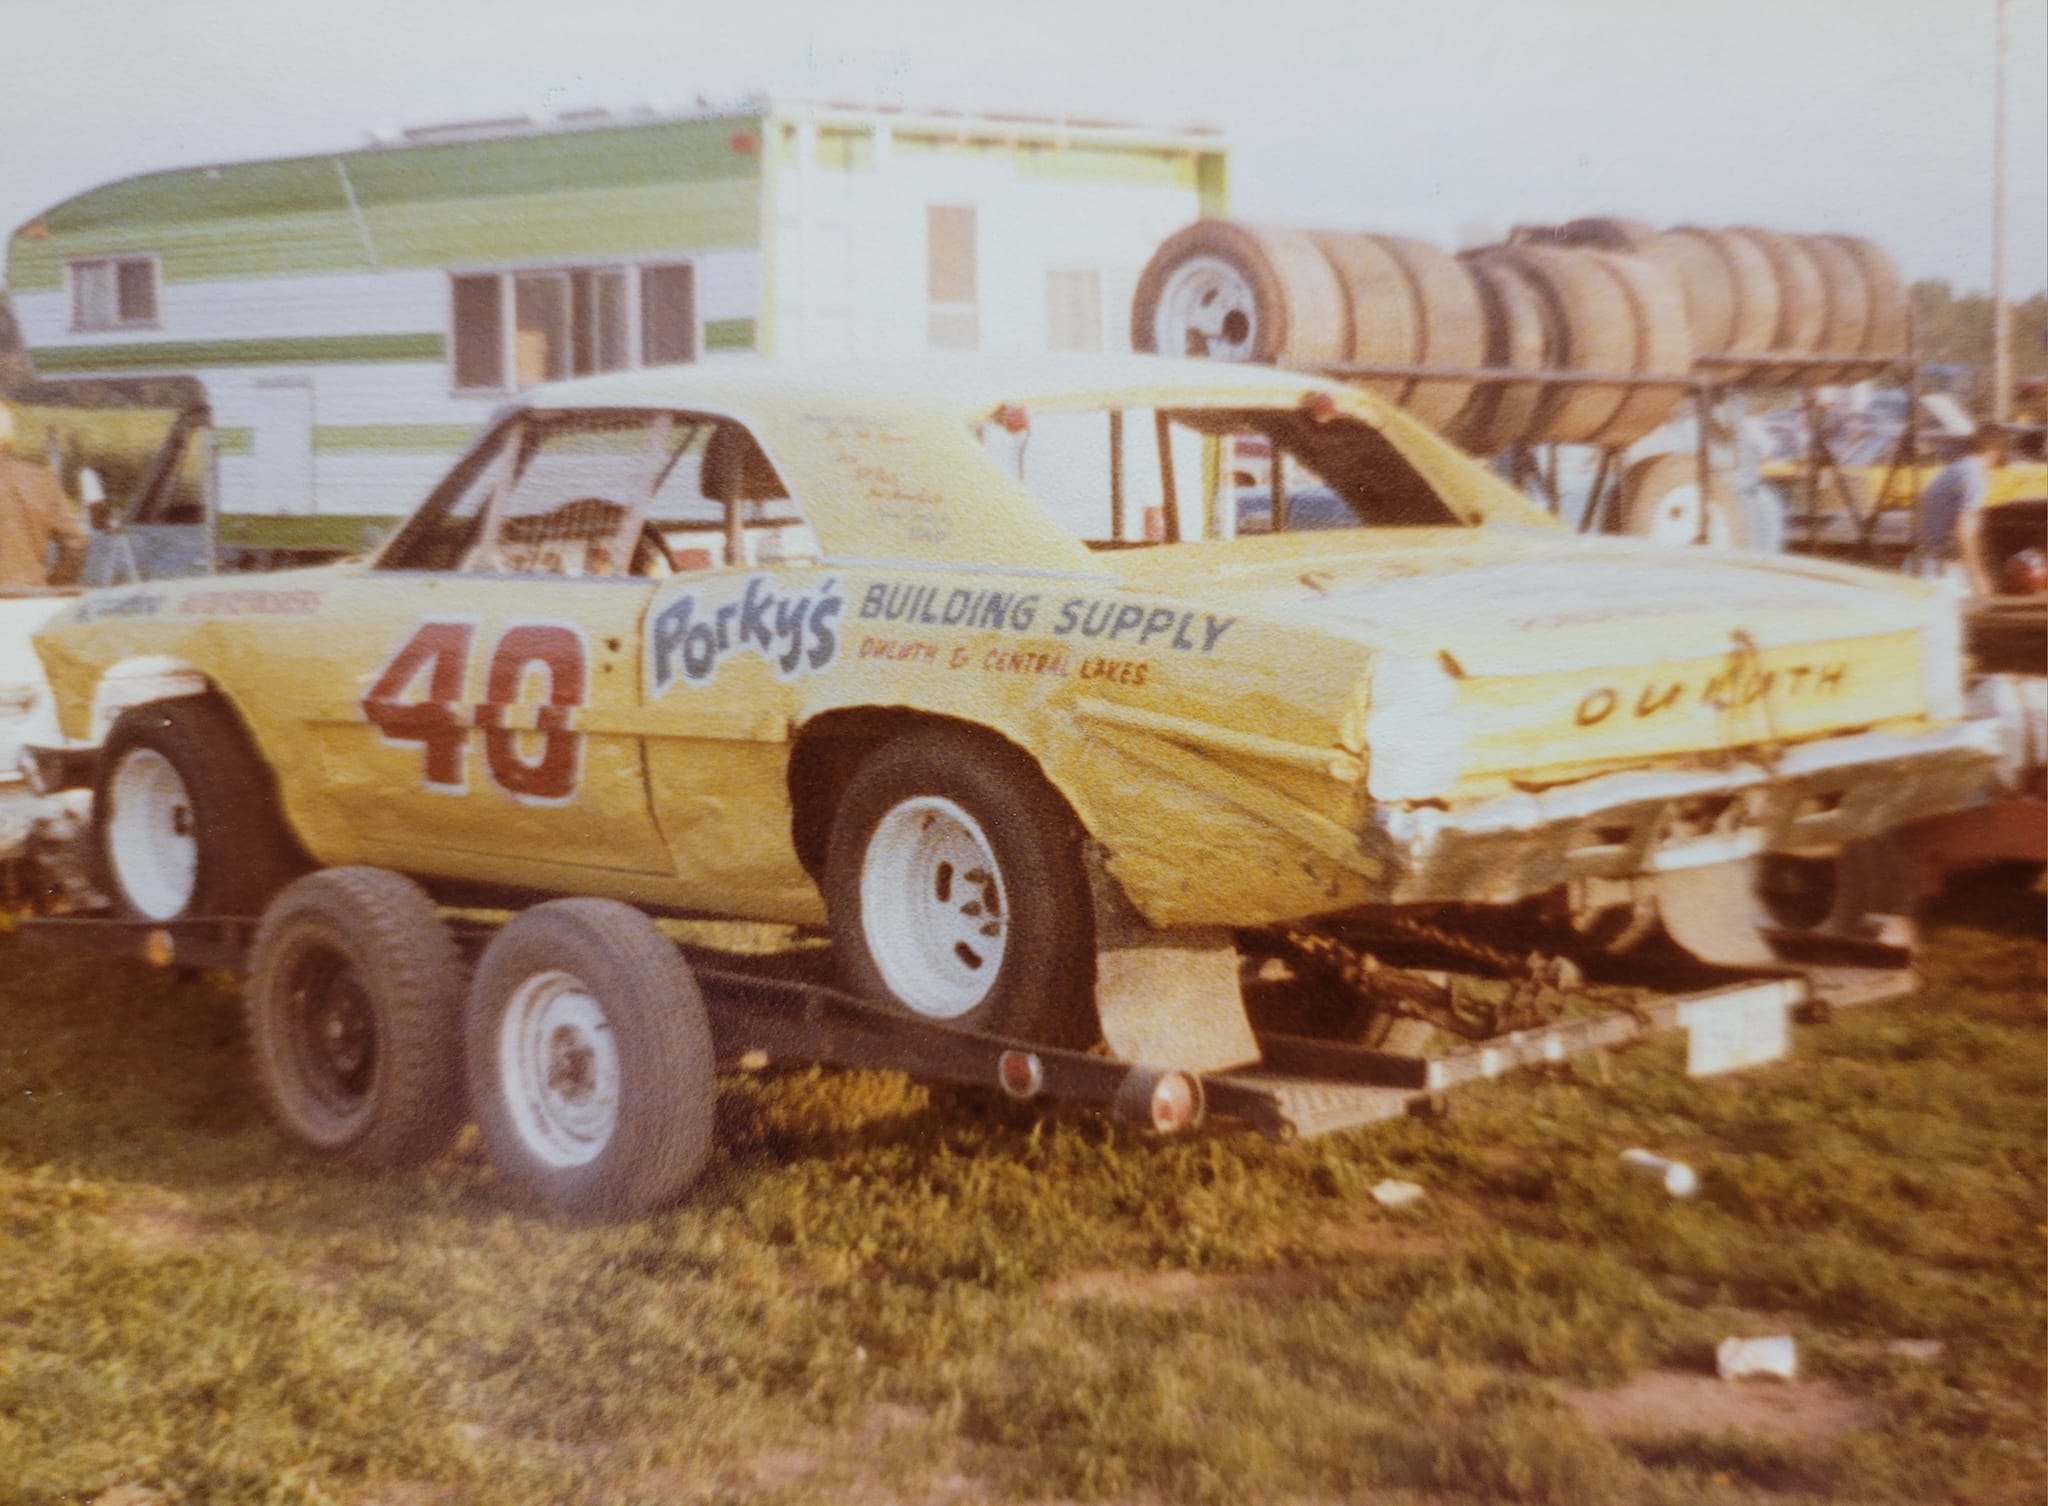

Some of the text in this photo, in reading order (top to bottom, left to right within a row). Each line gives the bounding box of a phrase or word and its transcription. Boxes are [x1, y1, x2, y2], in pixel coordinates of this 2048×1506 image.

[653, 575, 843, 690] Porky's
[858, 582, 1235, 653] BUILDING SUPPLY
[362, 617, 586, 806] 40
[983, 647, 1070, 678] CENTRAL
[1079, 656, 1149, 686] LAKES
